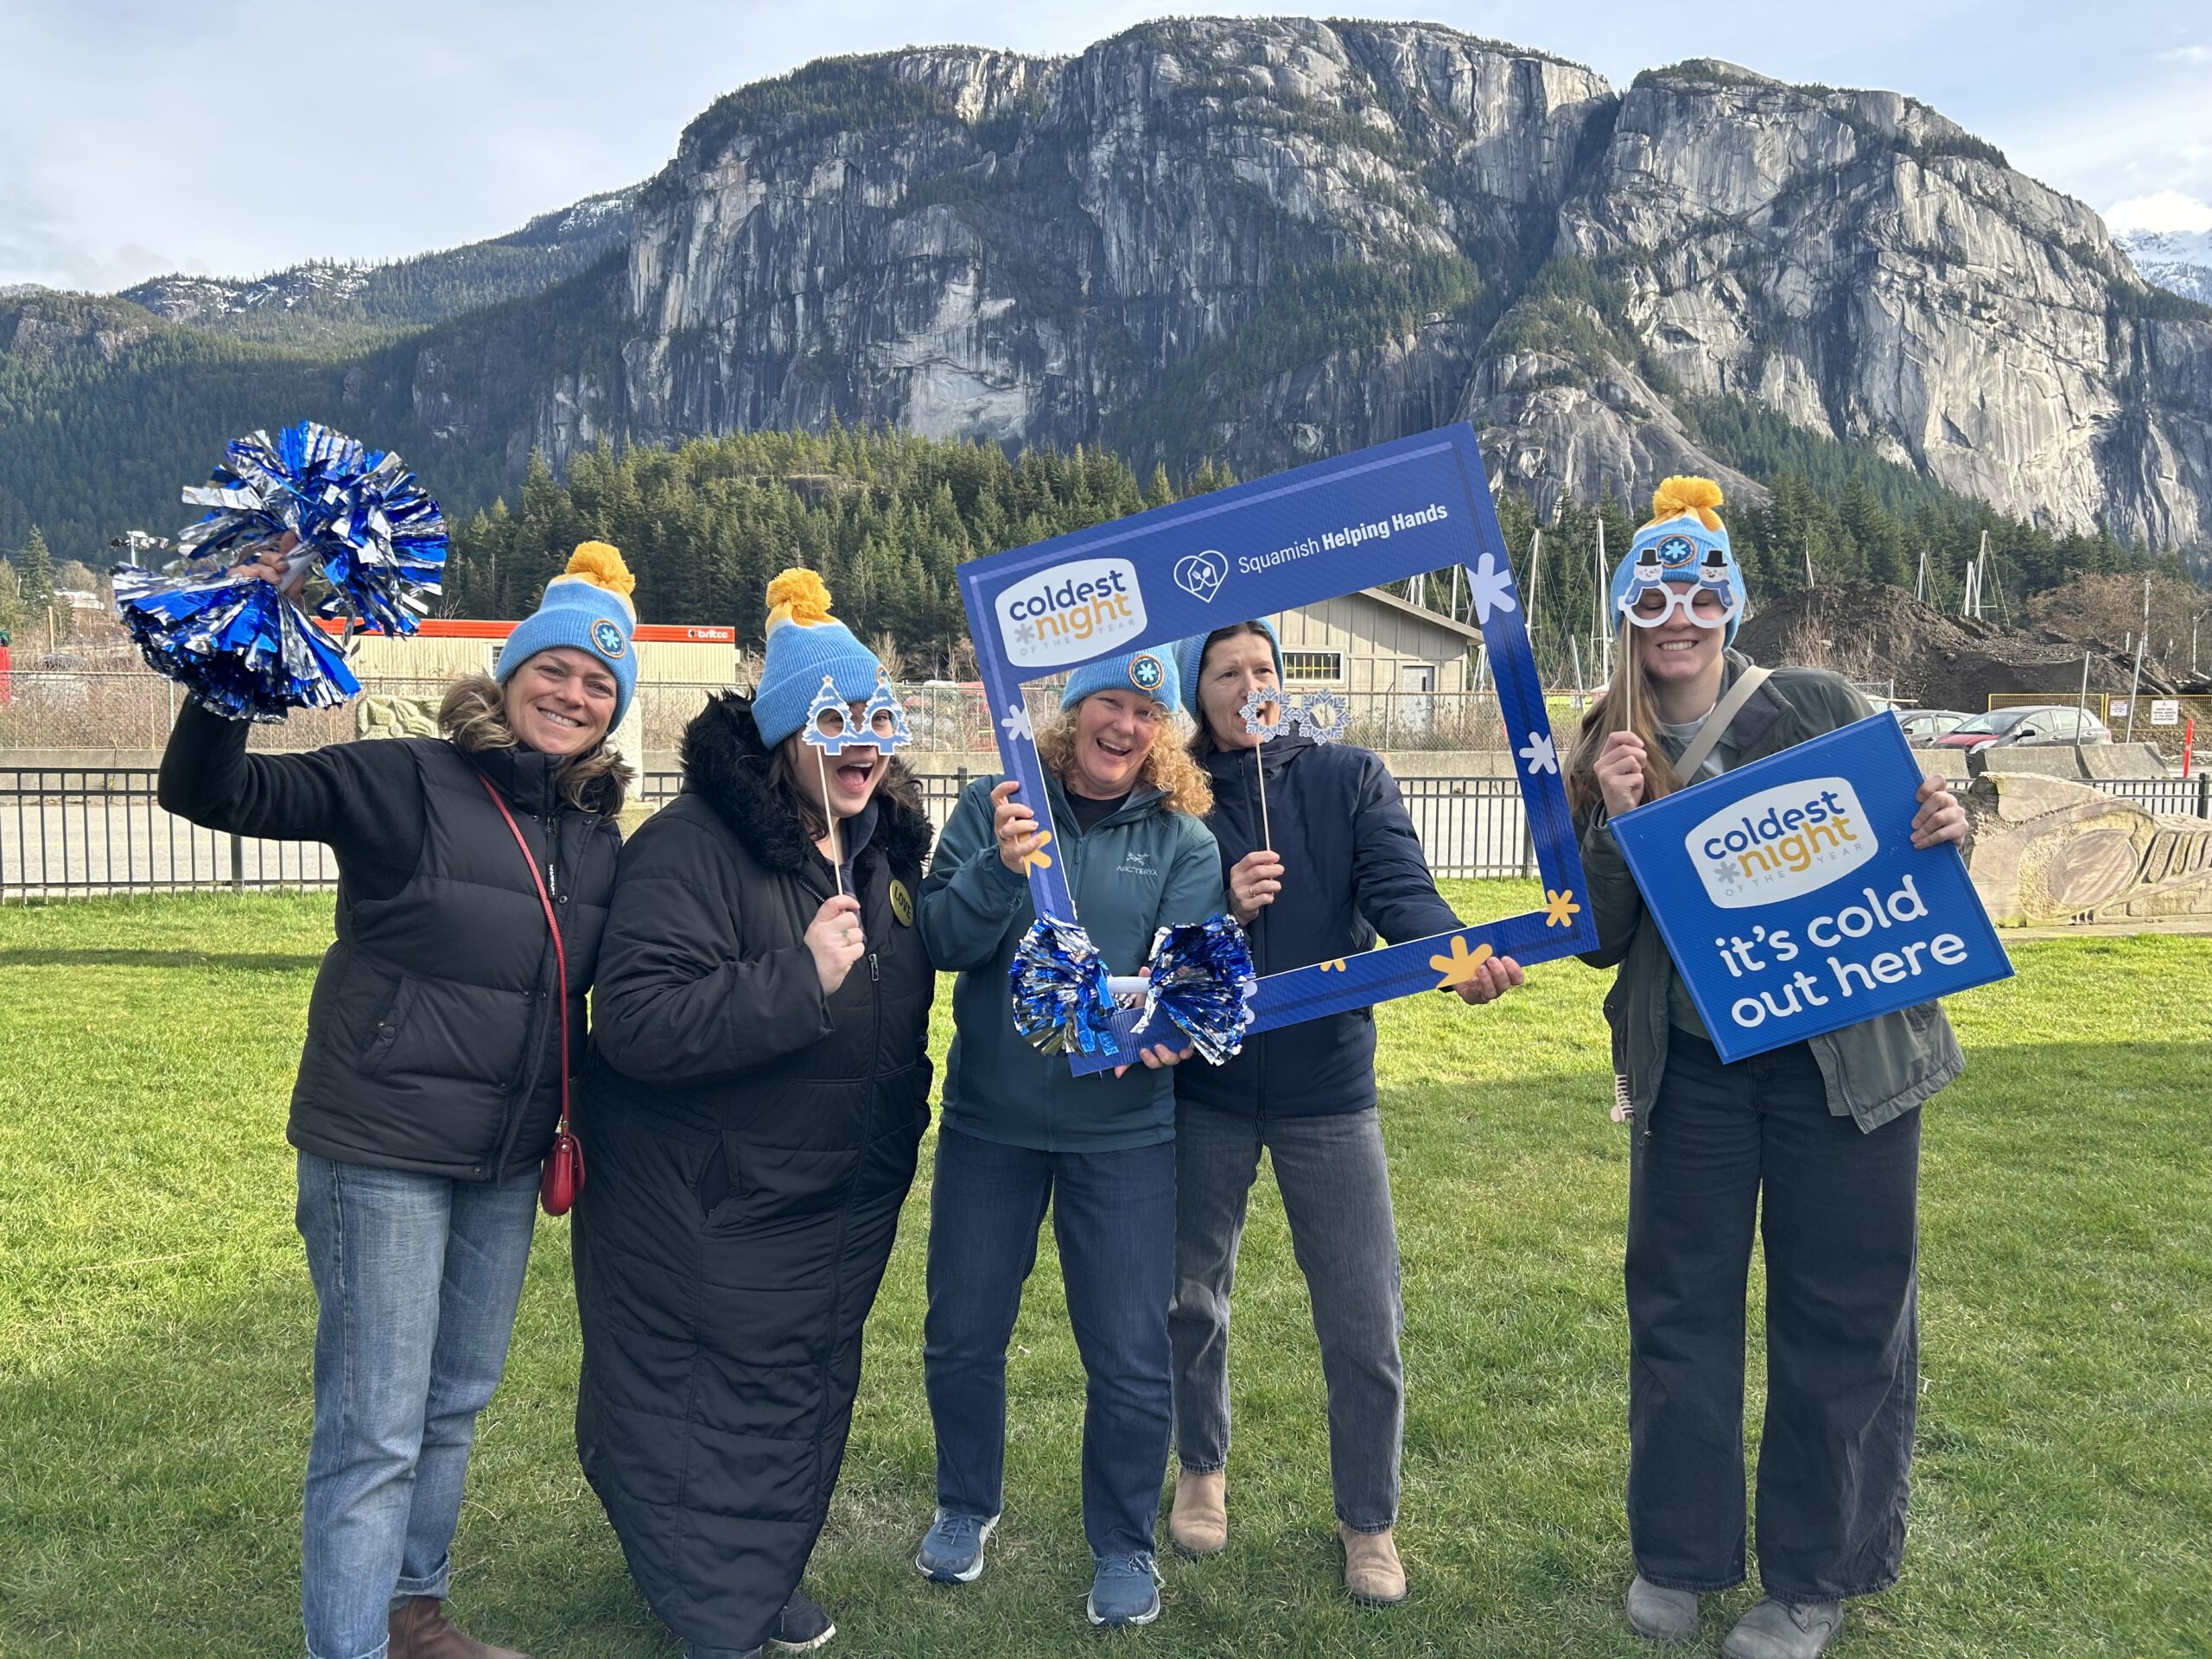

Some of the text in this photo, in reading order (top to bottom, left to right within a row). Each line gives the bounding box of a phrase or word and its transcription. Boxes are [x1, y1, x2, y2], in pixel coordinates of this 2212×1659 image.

[1238, 503, 1449, 575] Squamish Helping Hands
[1009, 569, 1127, 621] coldest
[1034, 593, 1133, 641] night
[1020, 619, 1136, 657] OF THE YEAR
[1704, 791, 1846, 860] coldest
[1738, 816, 1858, 878] night
[1725, 842, 1864, 897] OF THE YEAR
[894, 886, 912, 919] LOVE
[1715, 874, 1929, 977] it's cold
[1731, 933, 1968, 1028] out here
